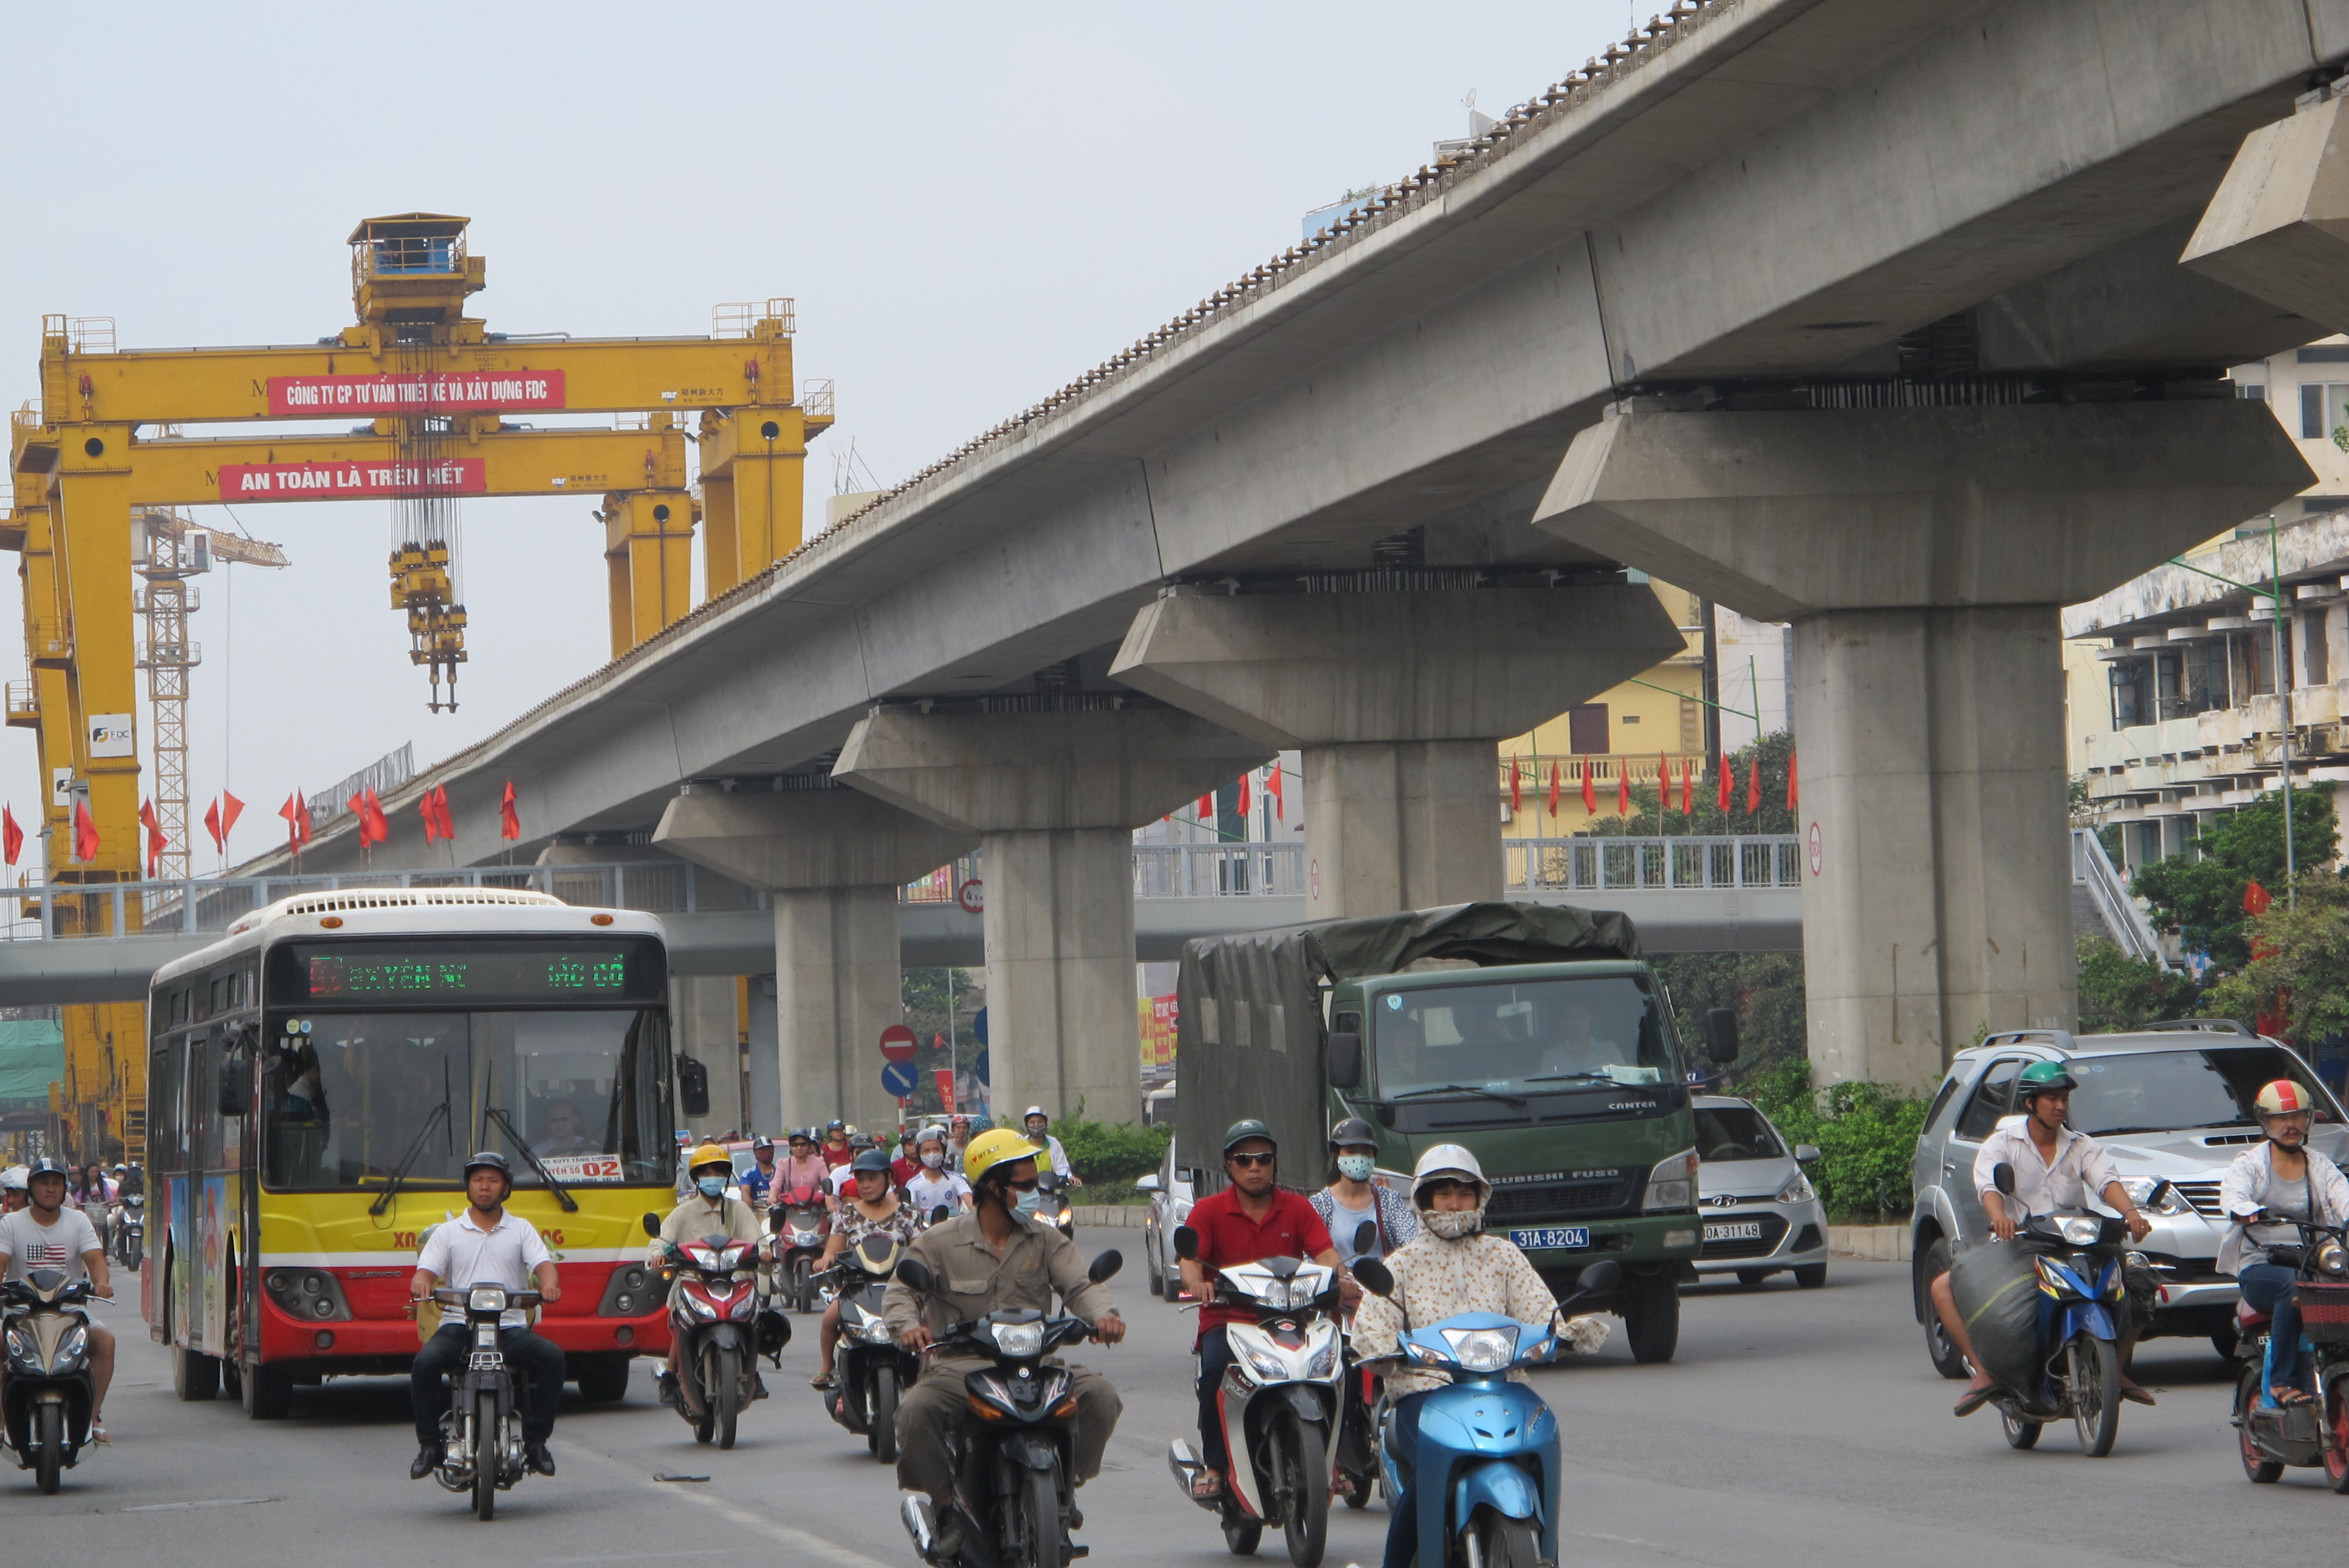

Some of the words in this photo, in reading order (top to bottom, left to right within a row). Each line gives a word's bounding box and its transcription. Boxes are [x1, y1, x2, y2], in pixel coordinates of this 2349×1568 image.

[287, 380, 319, 405] CÔNG
[321, 385, 334, 405] TY
[337, 384, 352, 404] CP
[355, 383, 370, 404] TƯ
[372, 375, 395, 403] VẤN
[431, 374, 446, 401] KẾ
[449, 377, 464, 401] VÀ
[466, 376, 489, 400] XÂY
[491, 379, 522, 403] DỰNG
[526, 379, 547, 400] FDC
[240, 473, 270, 490] AN
[276, 467, 330, 490] TOÀN
[336, 465, 362, 488] LÀ
[427, 460, 464, 485] HẾT
[110, 730, 129, 739] FDC
[1607, 1101, 1657, 1110] CANTER
[582, 1161, 620, 1177] 02
[1489, 1172, 1564, 1185] SUBISHI
[1572, 1169, 1619, 1179] FUSO
[1518, 1229, 1584, 1247] 31A-8204
